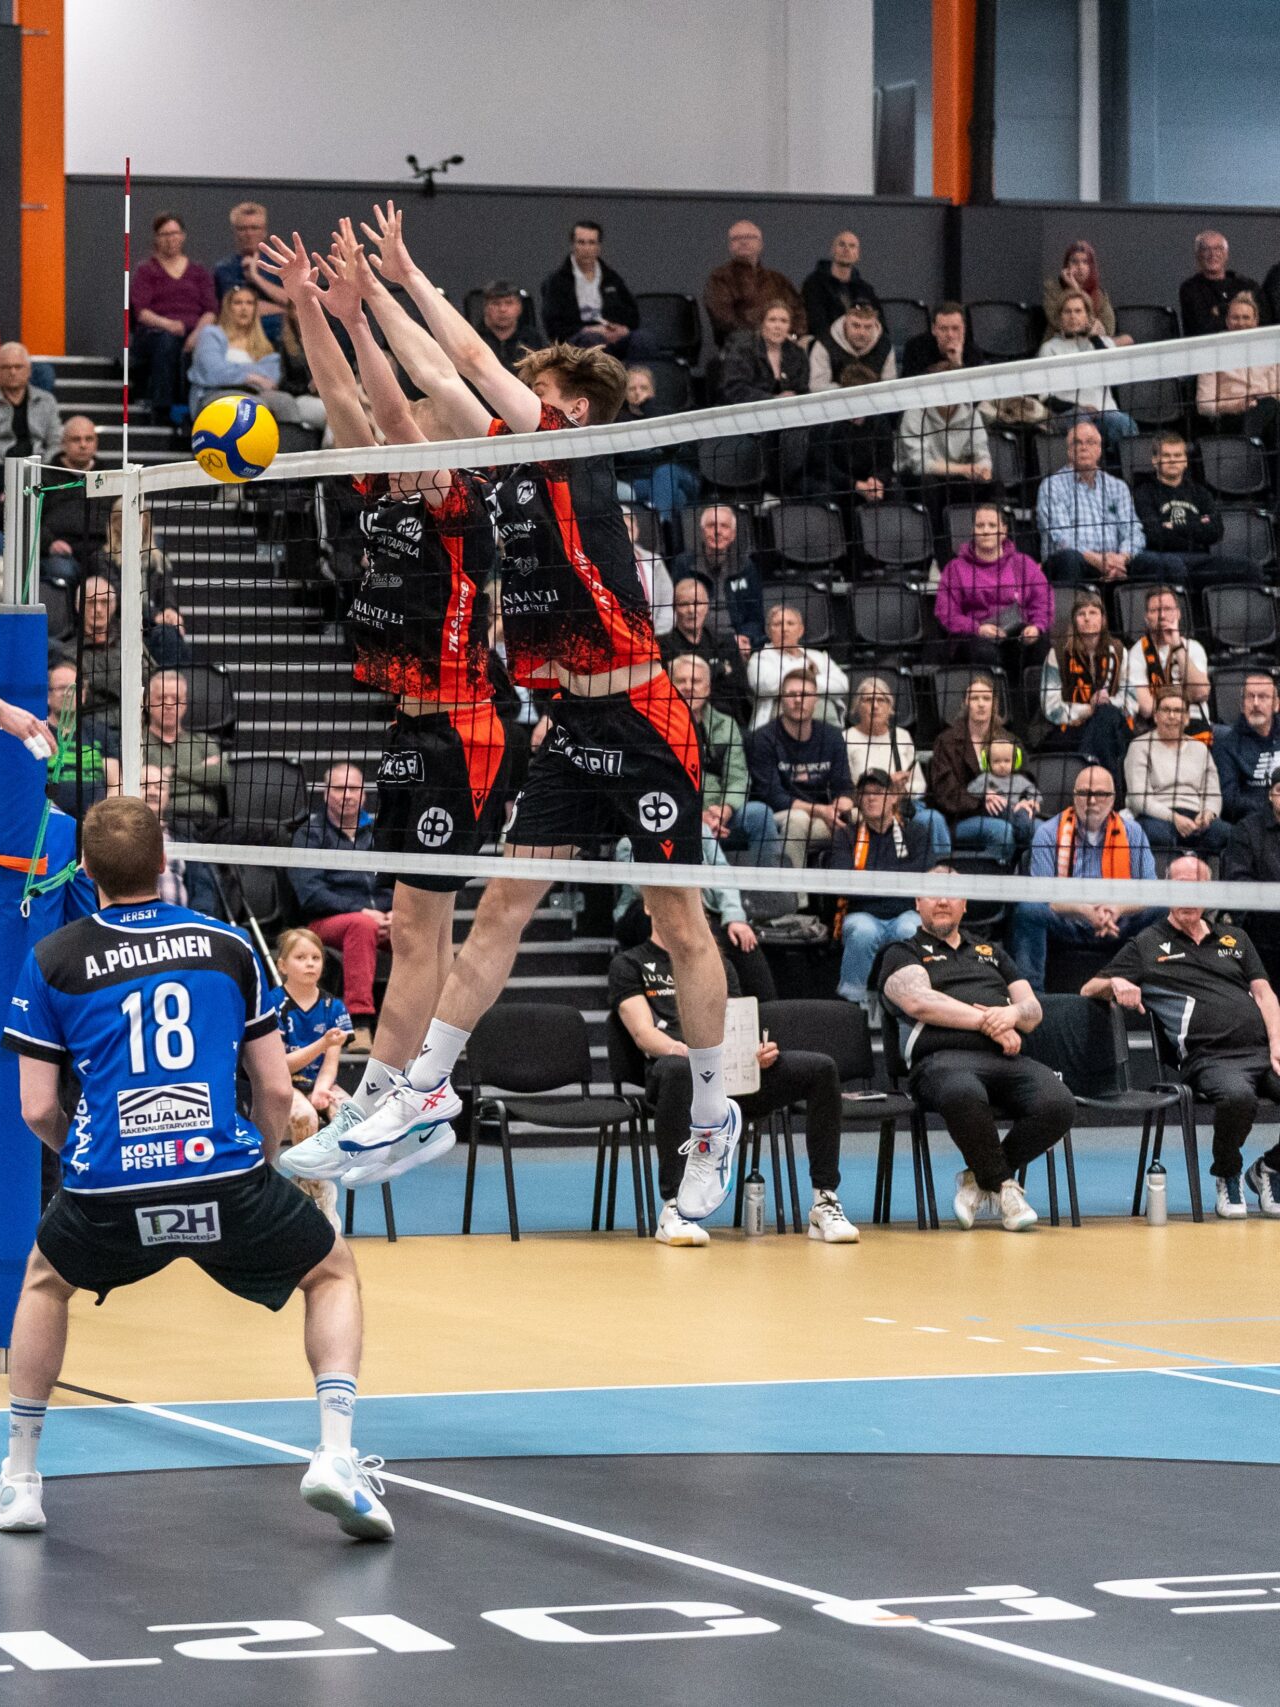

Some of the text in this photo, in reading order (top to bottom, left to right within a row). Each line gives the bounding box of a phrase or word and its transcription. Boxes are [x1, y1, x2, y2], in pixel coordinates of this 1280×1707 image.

[84, 935, 213, 980] A.PÖLLÄNEN
[120, 982, 196, 1074] 18
[120, 1107, 211, 1128] TOIJALAN
[120, 1119, 199, 1136] RAKENNUSTARVIKE
[121, 1140, 176, 1160] KONE
[121, 1155, 178, 1172] PISTE
